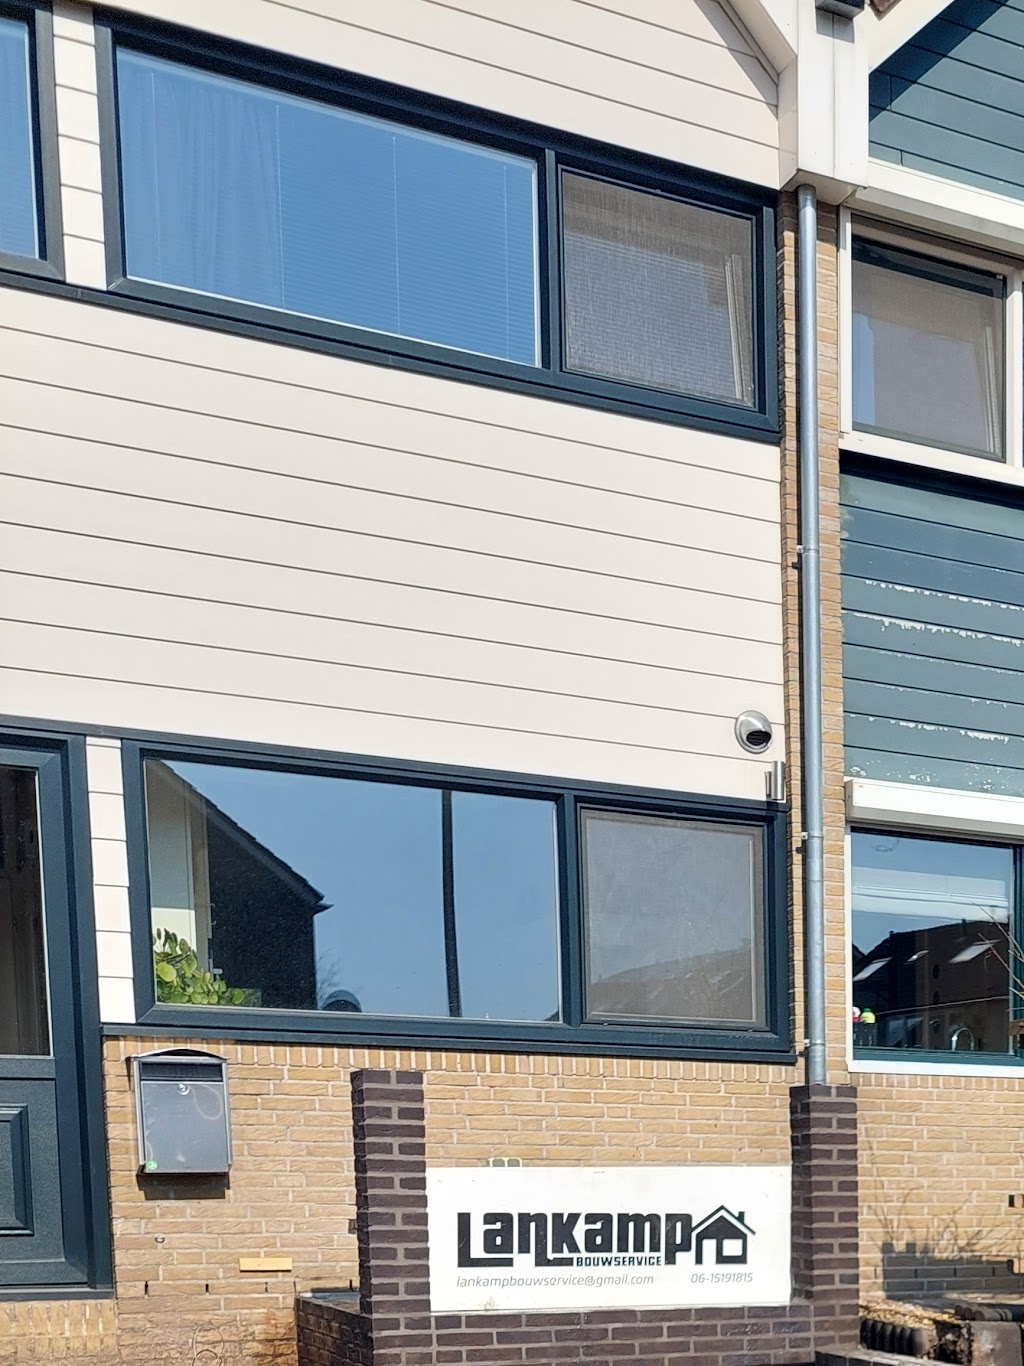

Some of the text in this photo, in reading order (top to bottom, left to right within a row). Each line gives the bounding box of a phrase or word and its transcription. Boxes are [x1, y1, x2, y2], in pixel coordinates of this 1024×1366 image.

[576, 1256, 662, 1267] BOUWSERVICE
[456, 1274, 654, 1288] lankampbouwservice@gmail.com
[690, 1272, 754, 1284] 06-15191815
